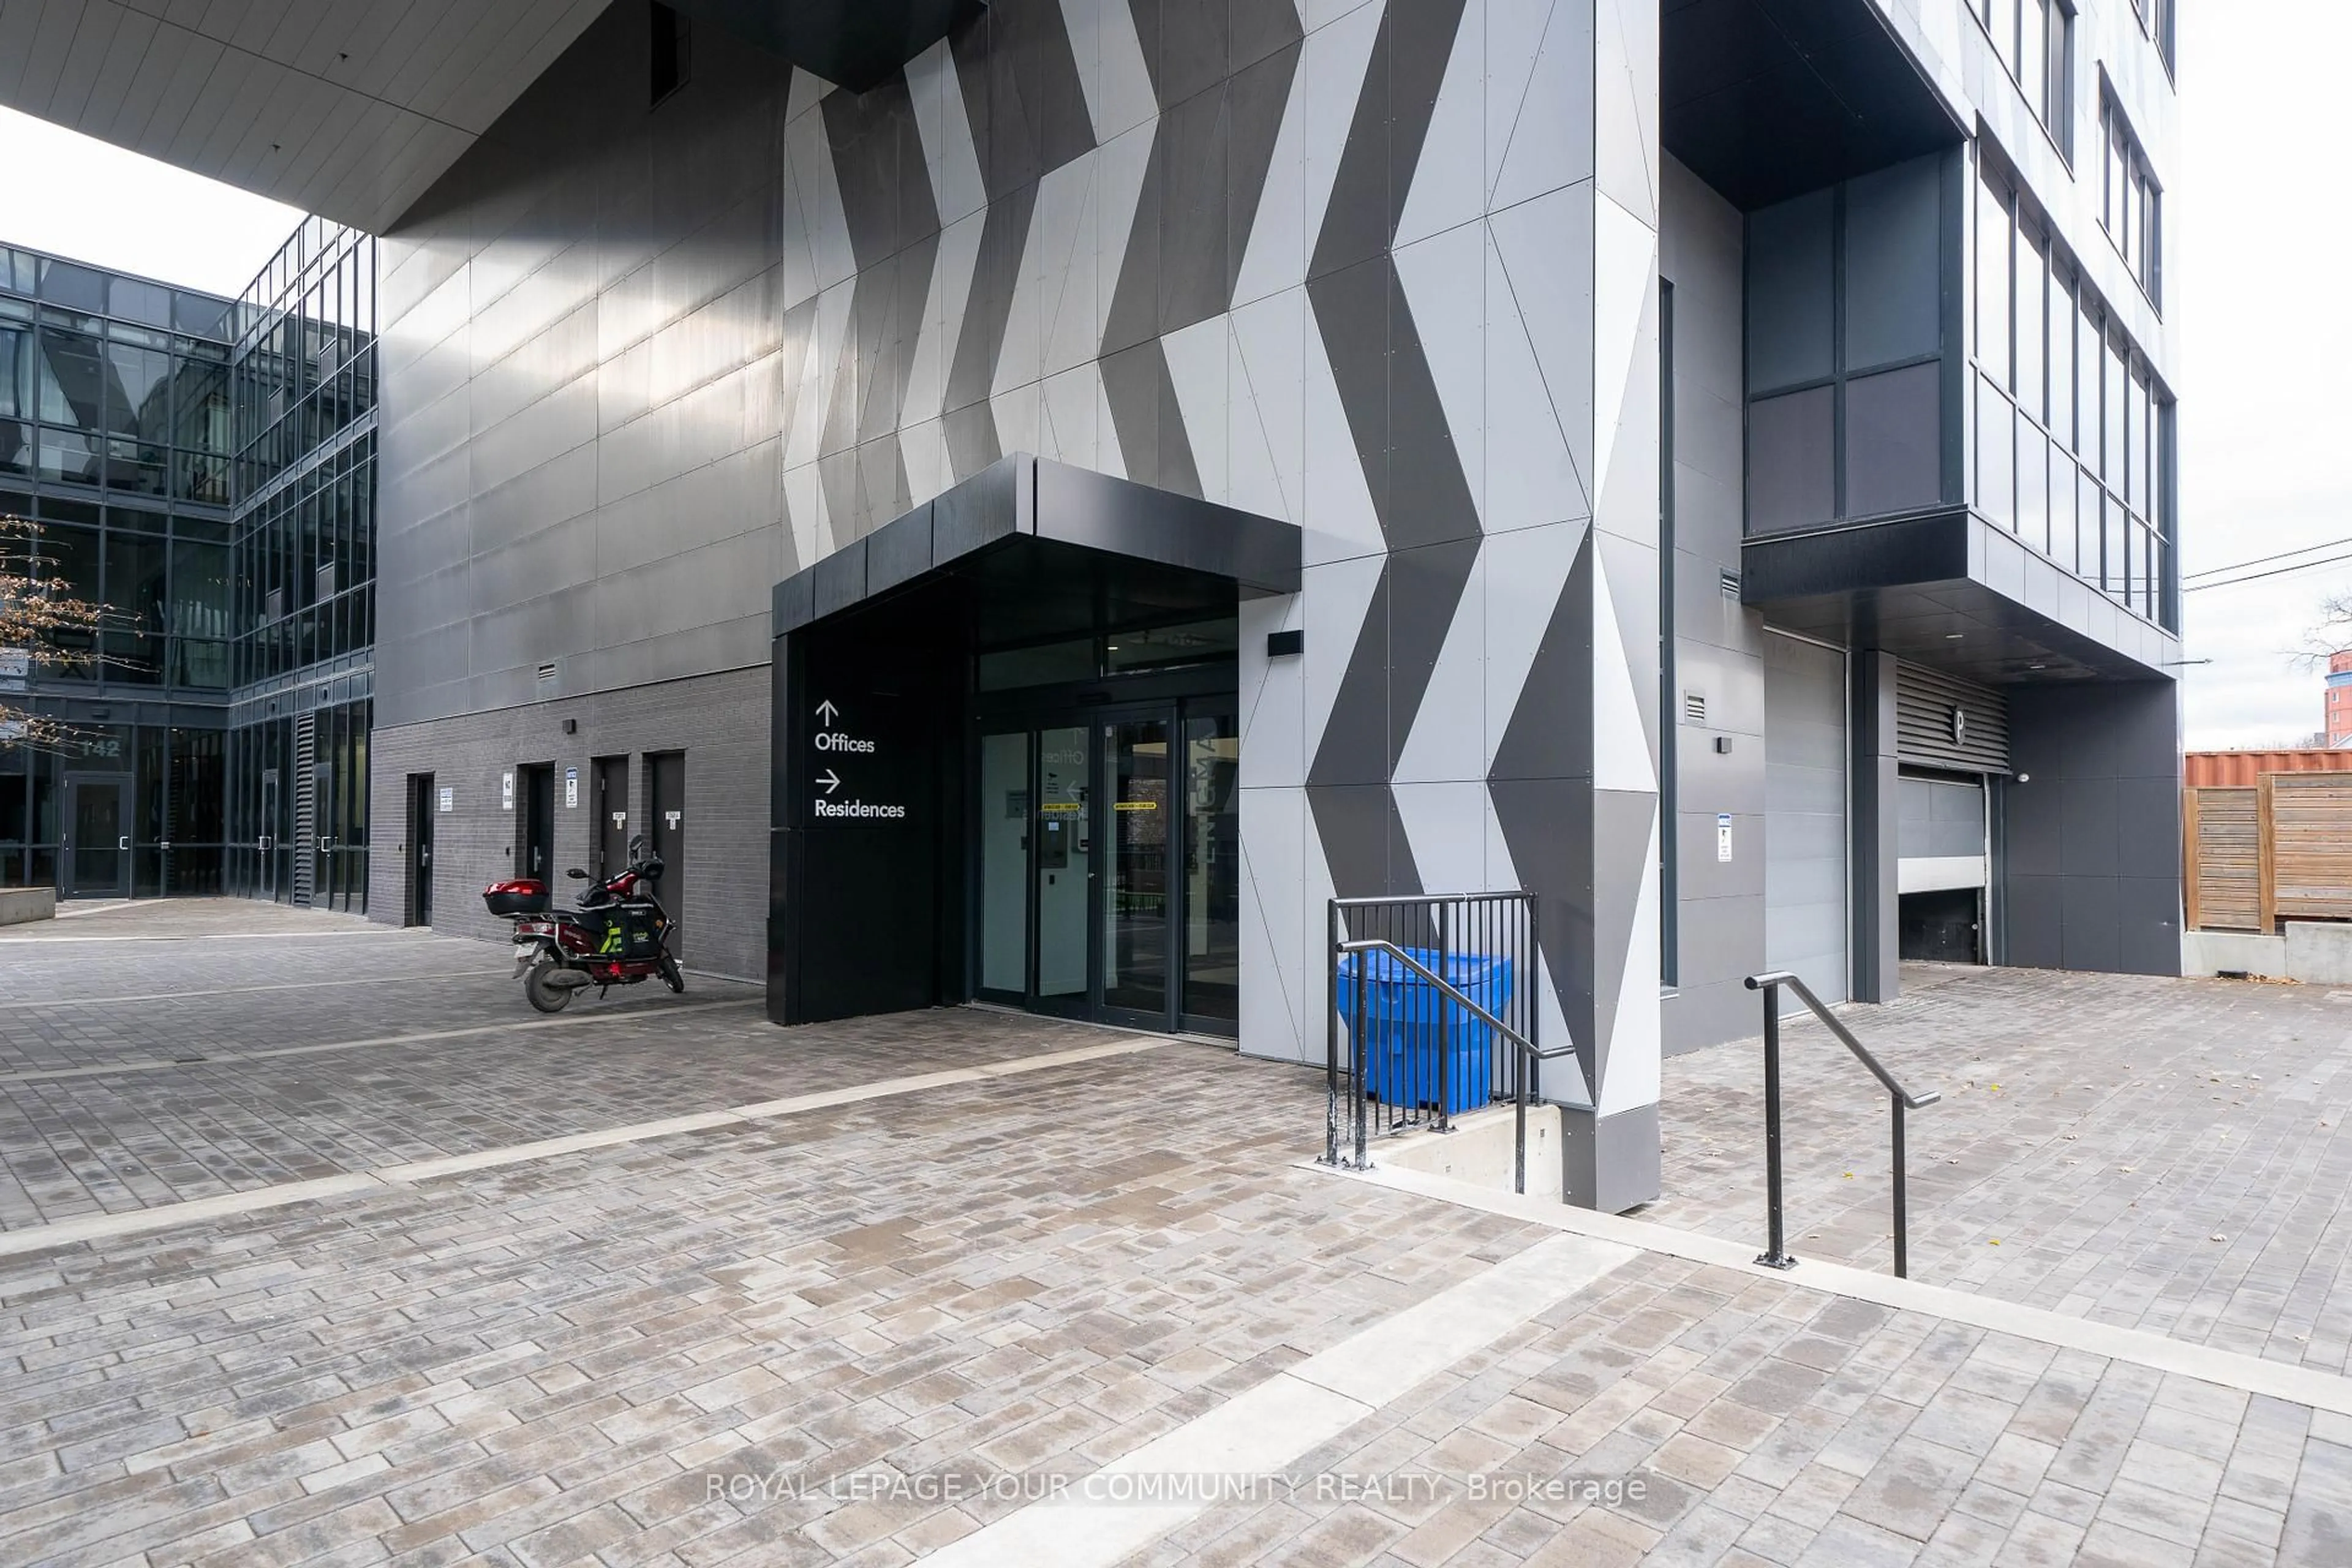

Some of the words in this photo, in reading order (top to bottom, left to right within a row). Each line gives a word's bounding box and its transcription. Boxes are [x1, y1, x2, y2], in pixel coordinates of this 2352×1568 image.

[1957, 710, 1964, 738] P
[815, 733, 875, 753] Offices
[815, 799, 905, 818] Residences
